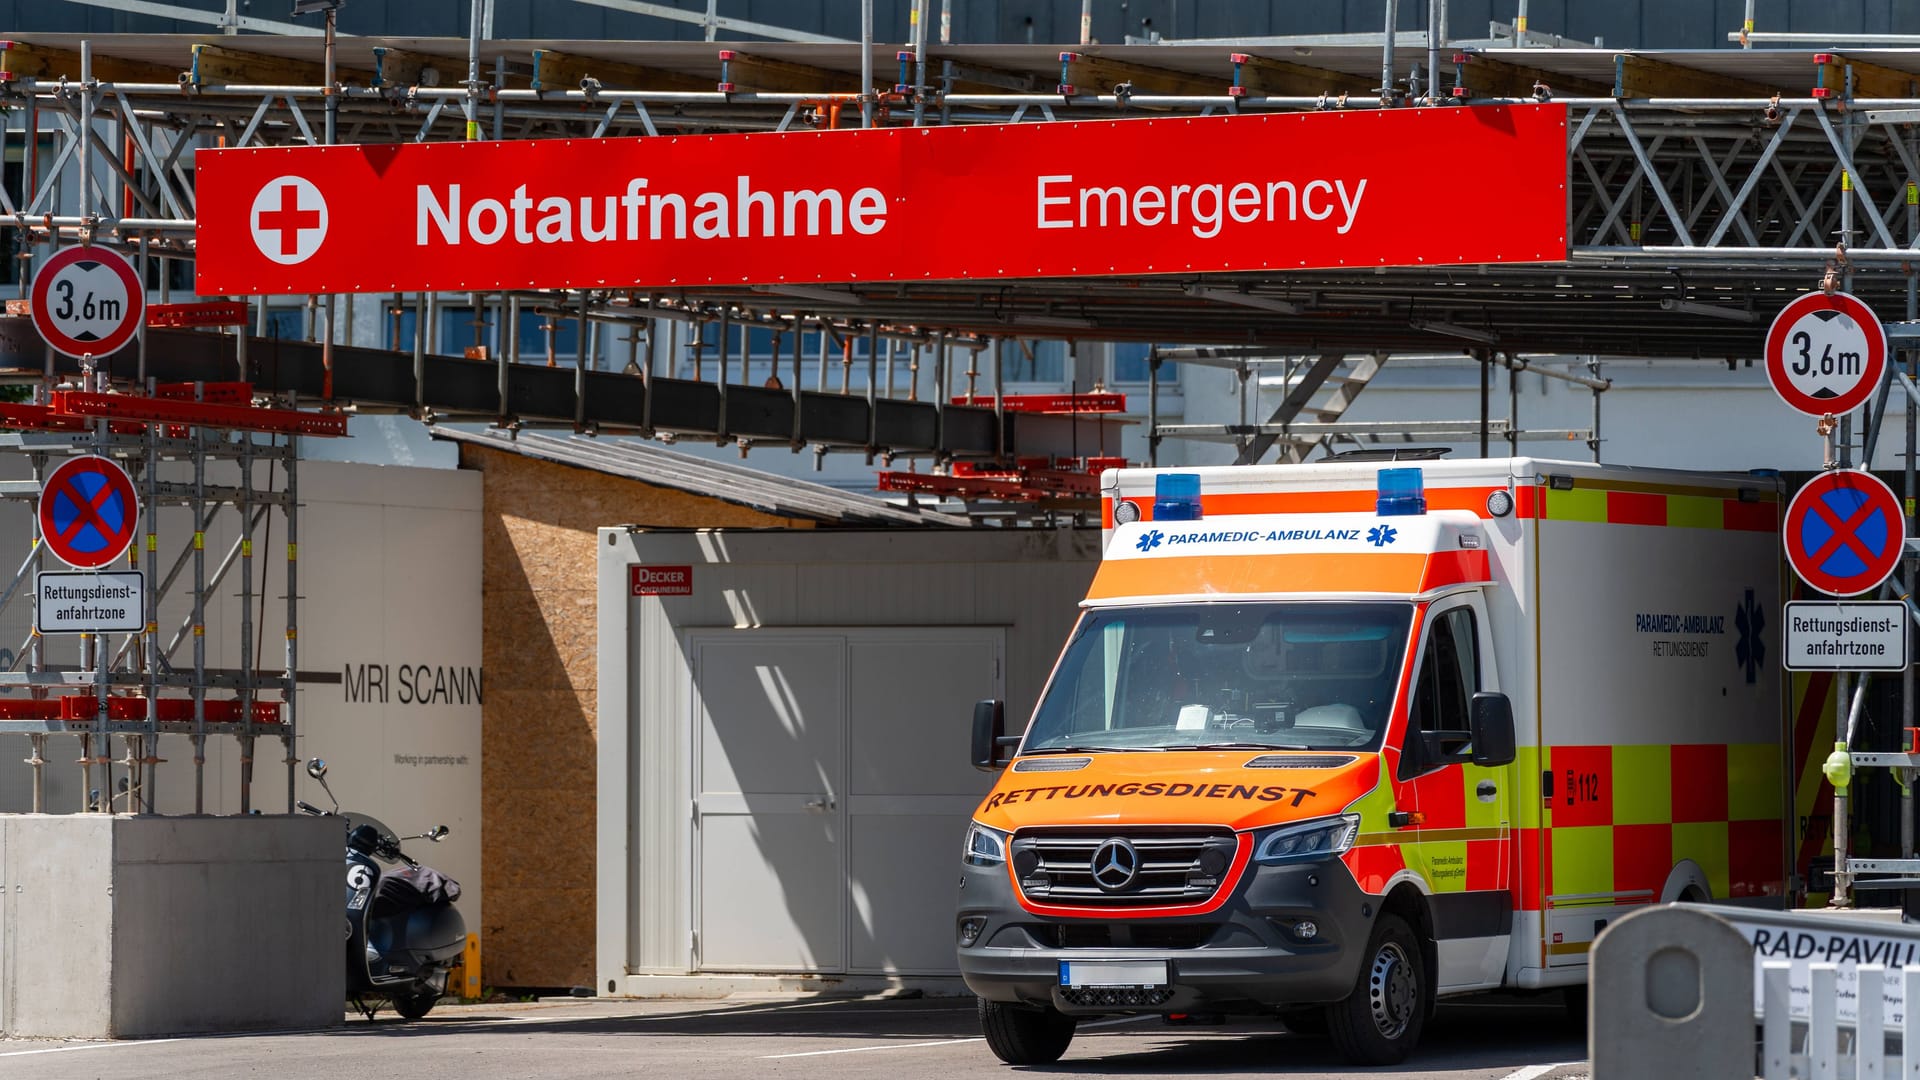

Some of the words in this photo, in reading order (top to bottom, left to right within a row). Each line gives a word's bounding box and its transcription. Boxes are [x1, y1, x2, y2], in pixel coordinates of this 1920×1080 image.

[416, 175, 888, 246] Notaufnahme
[1037, 174, 1368, 239] Emergency
[1167, 529, 1361, 545] PARAMEDIC-AMBULANZ
[639, 568, 685, 583] DECKER
[44, 585, 137, 603] Rettungsdienst-
[56, 605, 126, 620] anfahrtzone
[1636, 613, 1725, 634] PARAMEDIC-AMBULANZ
[1793, 616, 1899, 637] Rettungsdienst-
[1653, 640, 1709, 657] RETTUNGSDIENST
[1806, 639, 1886, 656] anfahrtzone
[345, 663, 389, 704] MRI
[984, 782, 1317, 813] RETTUNGSDIENST
[1579, 772, 1599, 802] 112
